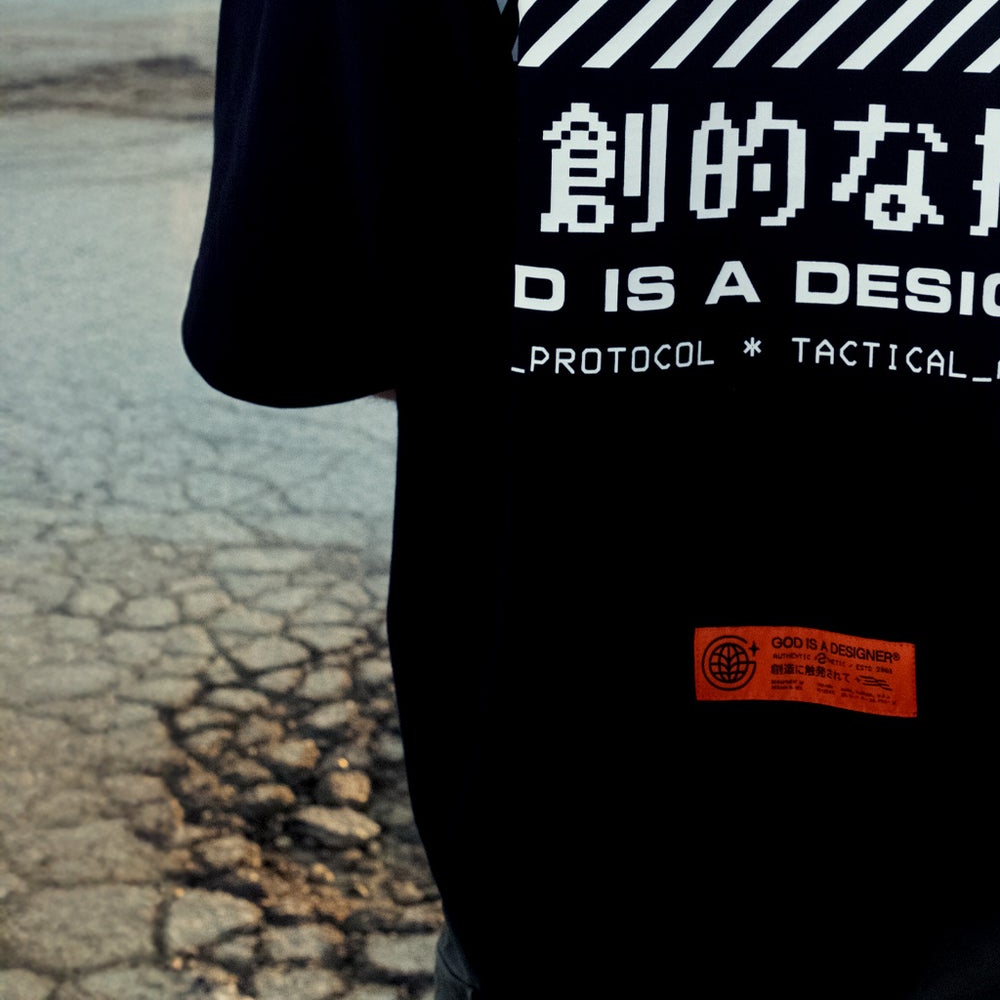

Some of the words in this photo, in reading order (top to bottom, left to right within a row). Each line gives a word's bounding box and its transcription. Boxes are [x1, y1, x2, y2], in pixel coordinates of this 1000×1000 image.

[604, 265, 676, 312] IS
[705, 260, 761, 305] A
[771, 636, 803, 649] GOD
[805, 638, 817, 650] IS
[820, 641, 828, 652] A
